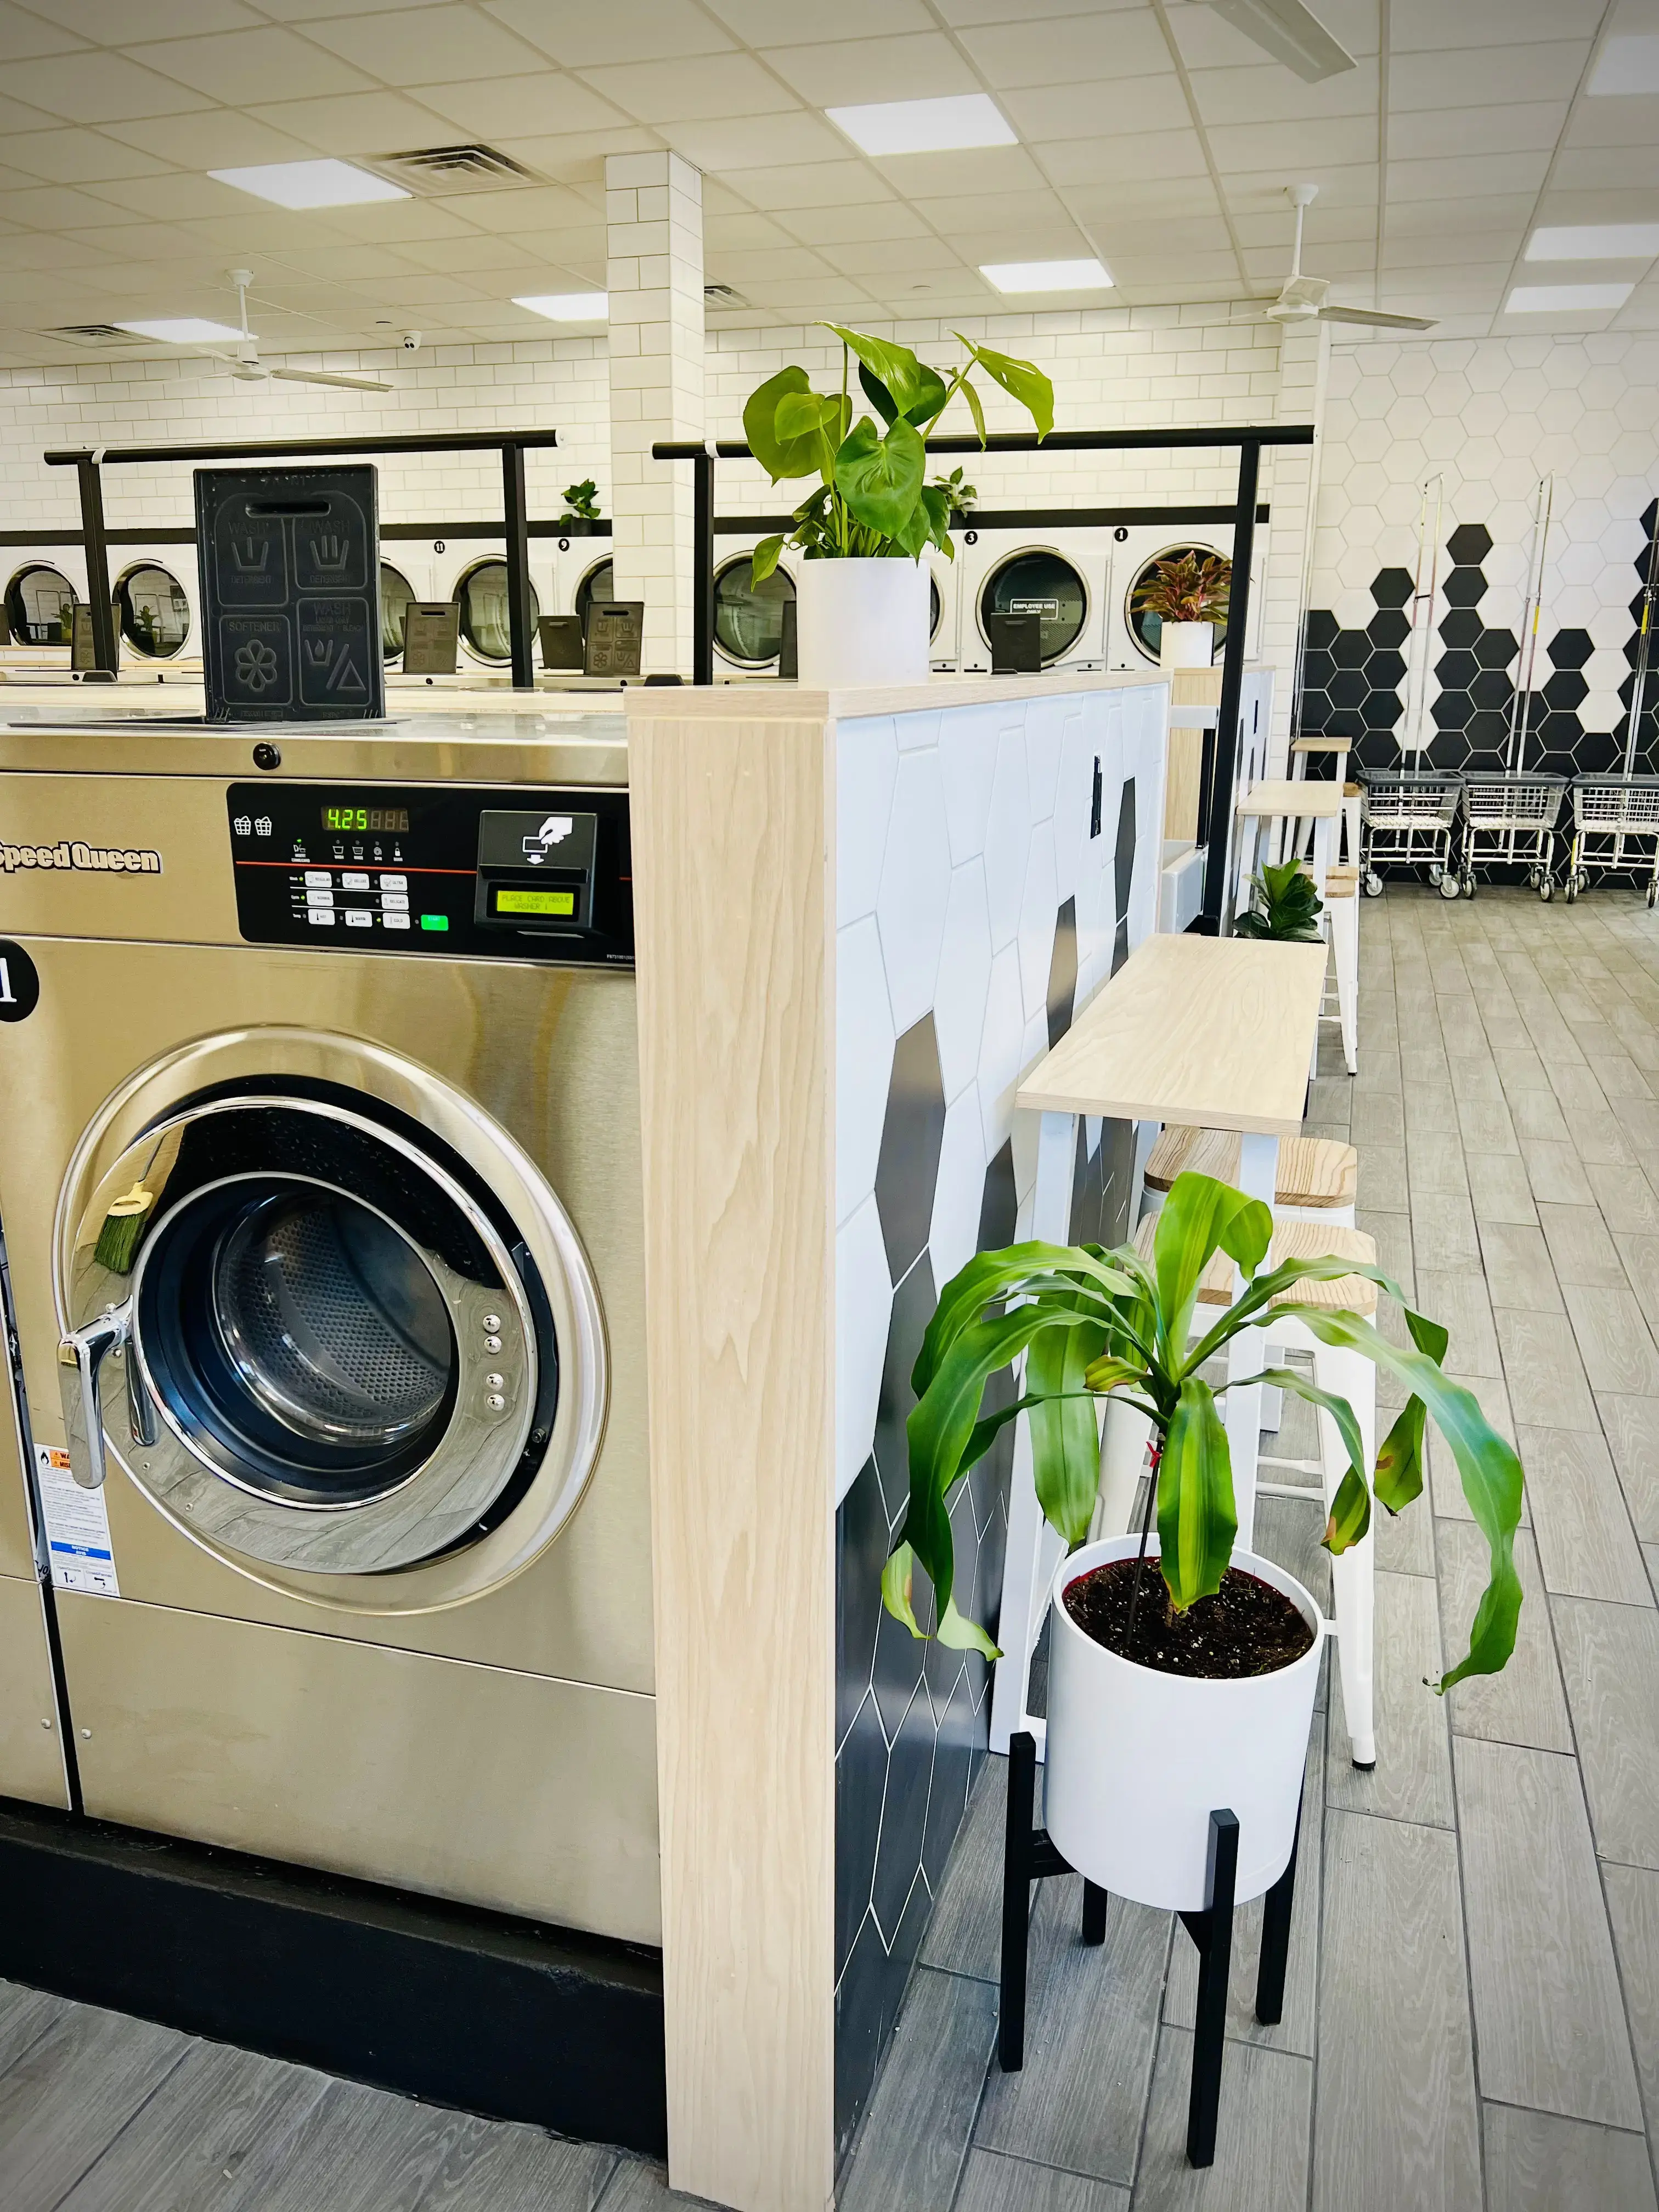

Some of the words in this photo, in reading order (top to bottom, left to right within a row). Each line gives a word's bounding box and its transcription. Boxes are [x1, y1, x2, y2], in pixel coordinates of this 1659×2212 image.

[967, 533, 975, 543] 3
[435, 543, 444, 551] 11
[561, 540, 567, 549] 9
[229, 621, 281, 632] SOFTENER
[328, 808, 367, 831] 4.25
